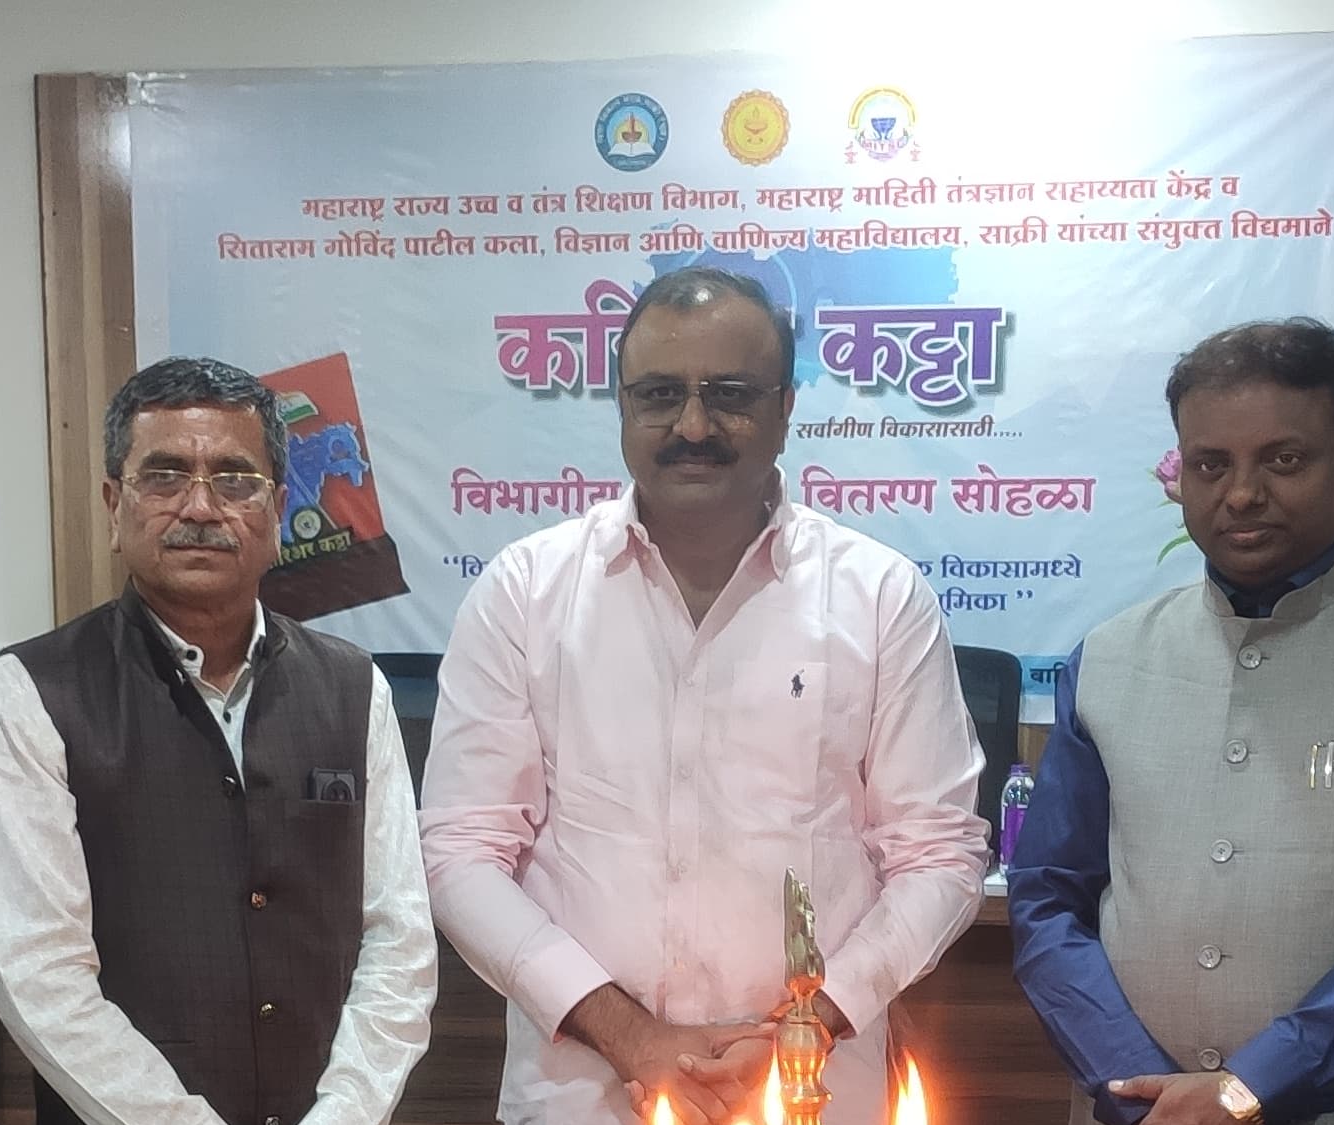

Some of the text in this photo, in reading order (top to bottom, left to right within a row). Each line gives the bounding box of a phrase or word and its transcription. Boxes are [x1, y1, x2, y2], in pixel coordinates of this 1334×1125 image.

[302, 170, 1241, 221] महाराष्ट्र राज्य उच्च व तंत्र शिक्षण विभाग, महाराष्ट्र माहिती तंत्रज्ञान सहाय्यता केंद्र व
[218, 232, 315, 260] सिताराम
[324, 230, 396, 259] गोविंद
[404, 229, 476, 256] पाटील
[483, 234, 546, 257] कला,
[555, 226, 630, 255] विज्ञान
[639, 224, 705, 253] आणि
[713, 222, 807, 250] वाणिज्य
[979, 216, 1048, 247] साक्री
[1057, 214, 1128, 243] यांच्या
[1137, 212, 1222, 250] संयुक्त
[1231, 207, 1334, 240] विद्यमाने
[817, 306, 1003, 406] कट्टा
[451, 464, 1095, 517] विभागीय वितरण सोहळा
[941, 554, 1083, 579] विकासामध्ये
